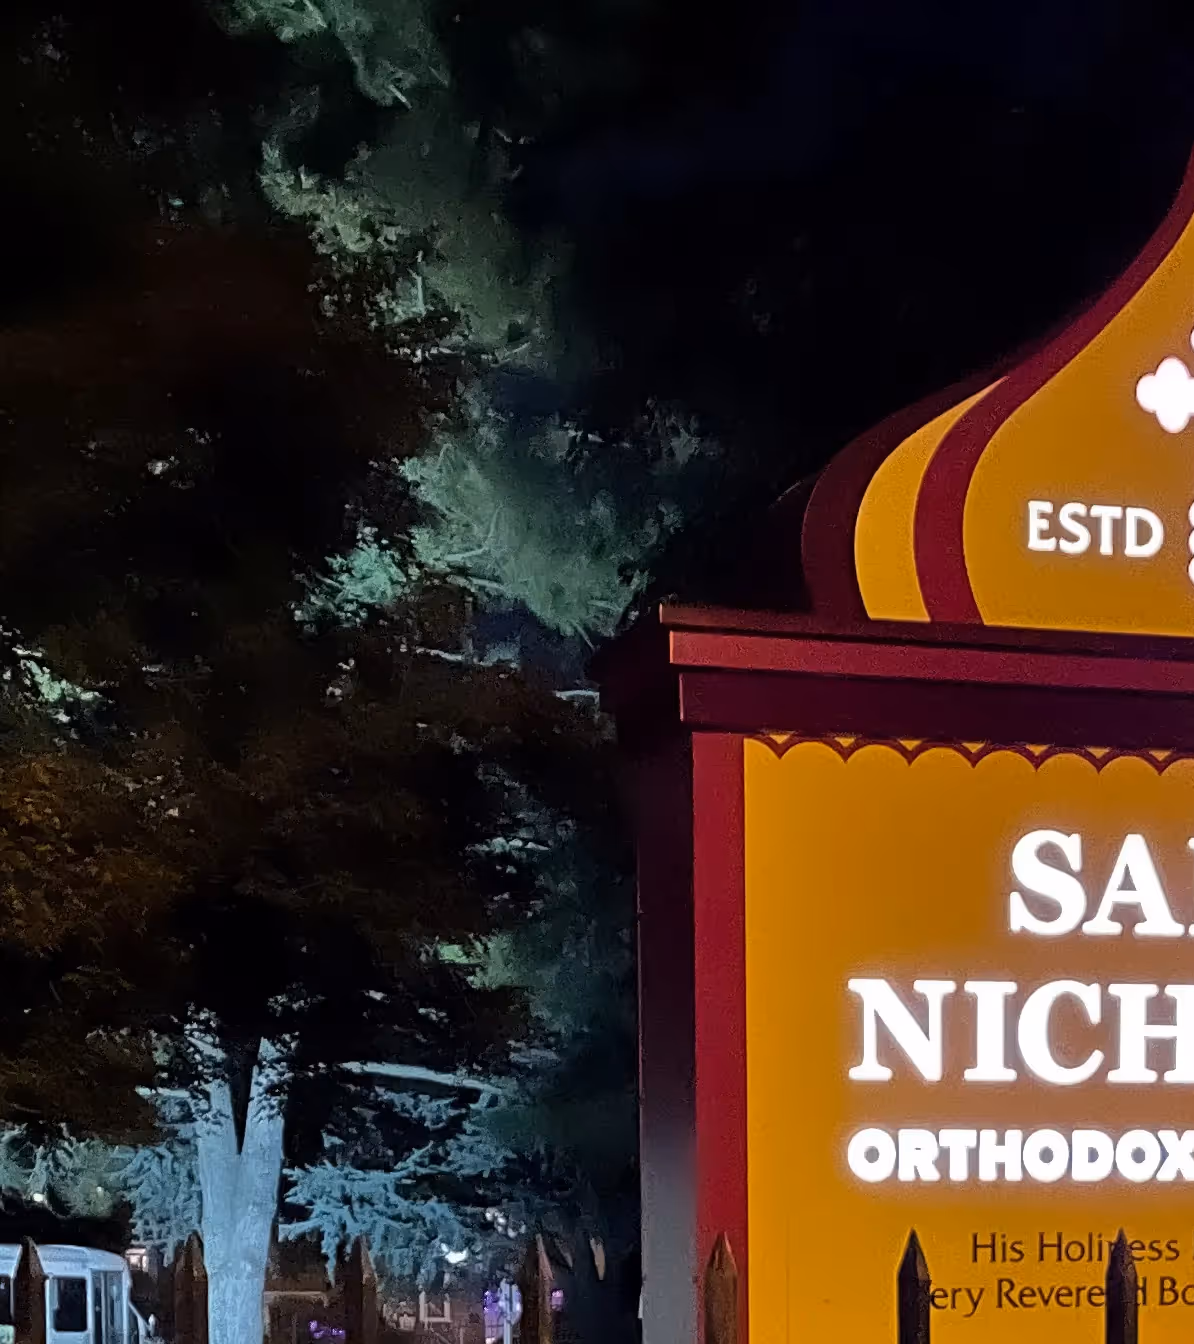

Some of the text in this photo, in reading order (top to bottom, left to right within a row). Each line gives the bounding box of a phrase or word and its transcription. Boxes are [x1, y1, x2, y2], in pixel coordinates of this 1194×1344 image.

[1027, 500, 1164, 557] ESTD
[972, 1232, 1025, 1263] His
[1038, 1231, 1180, 1263] Holiess
[921, 1279, 985, 1318] ery
[996, 1277, 1148, 1309] Revered
